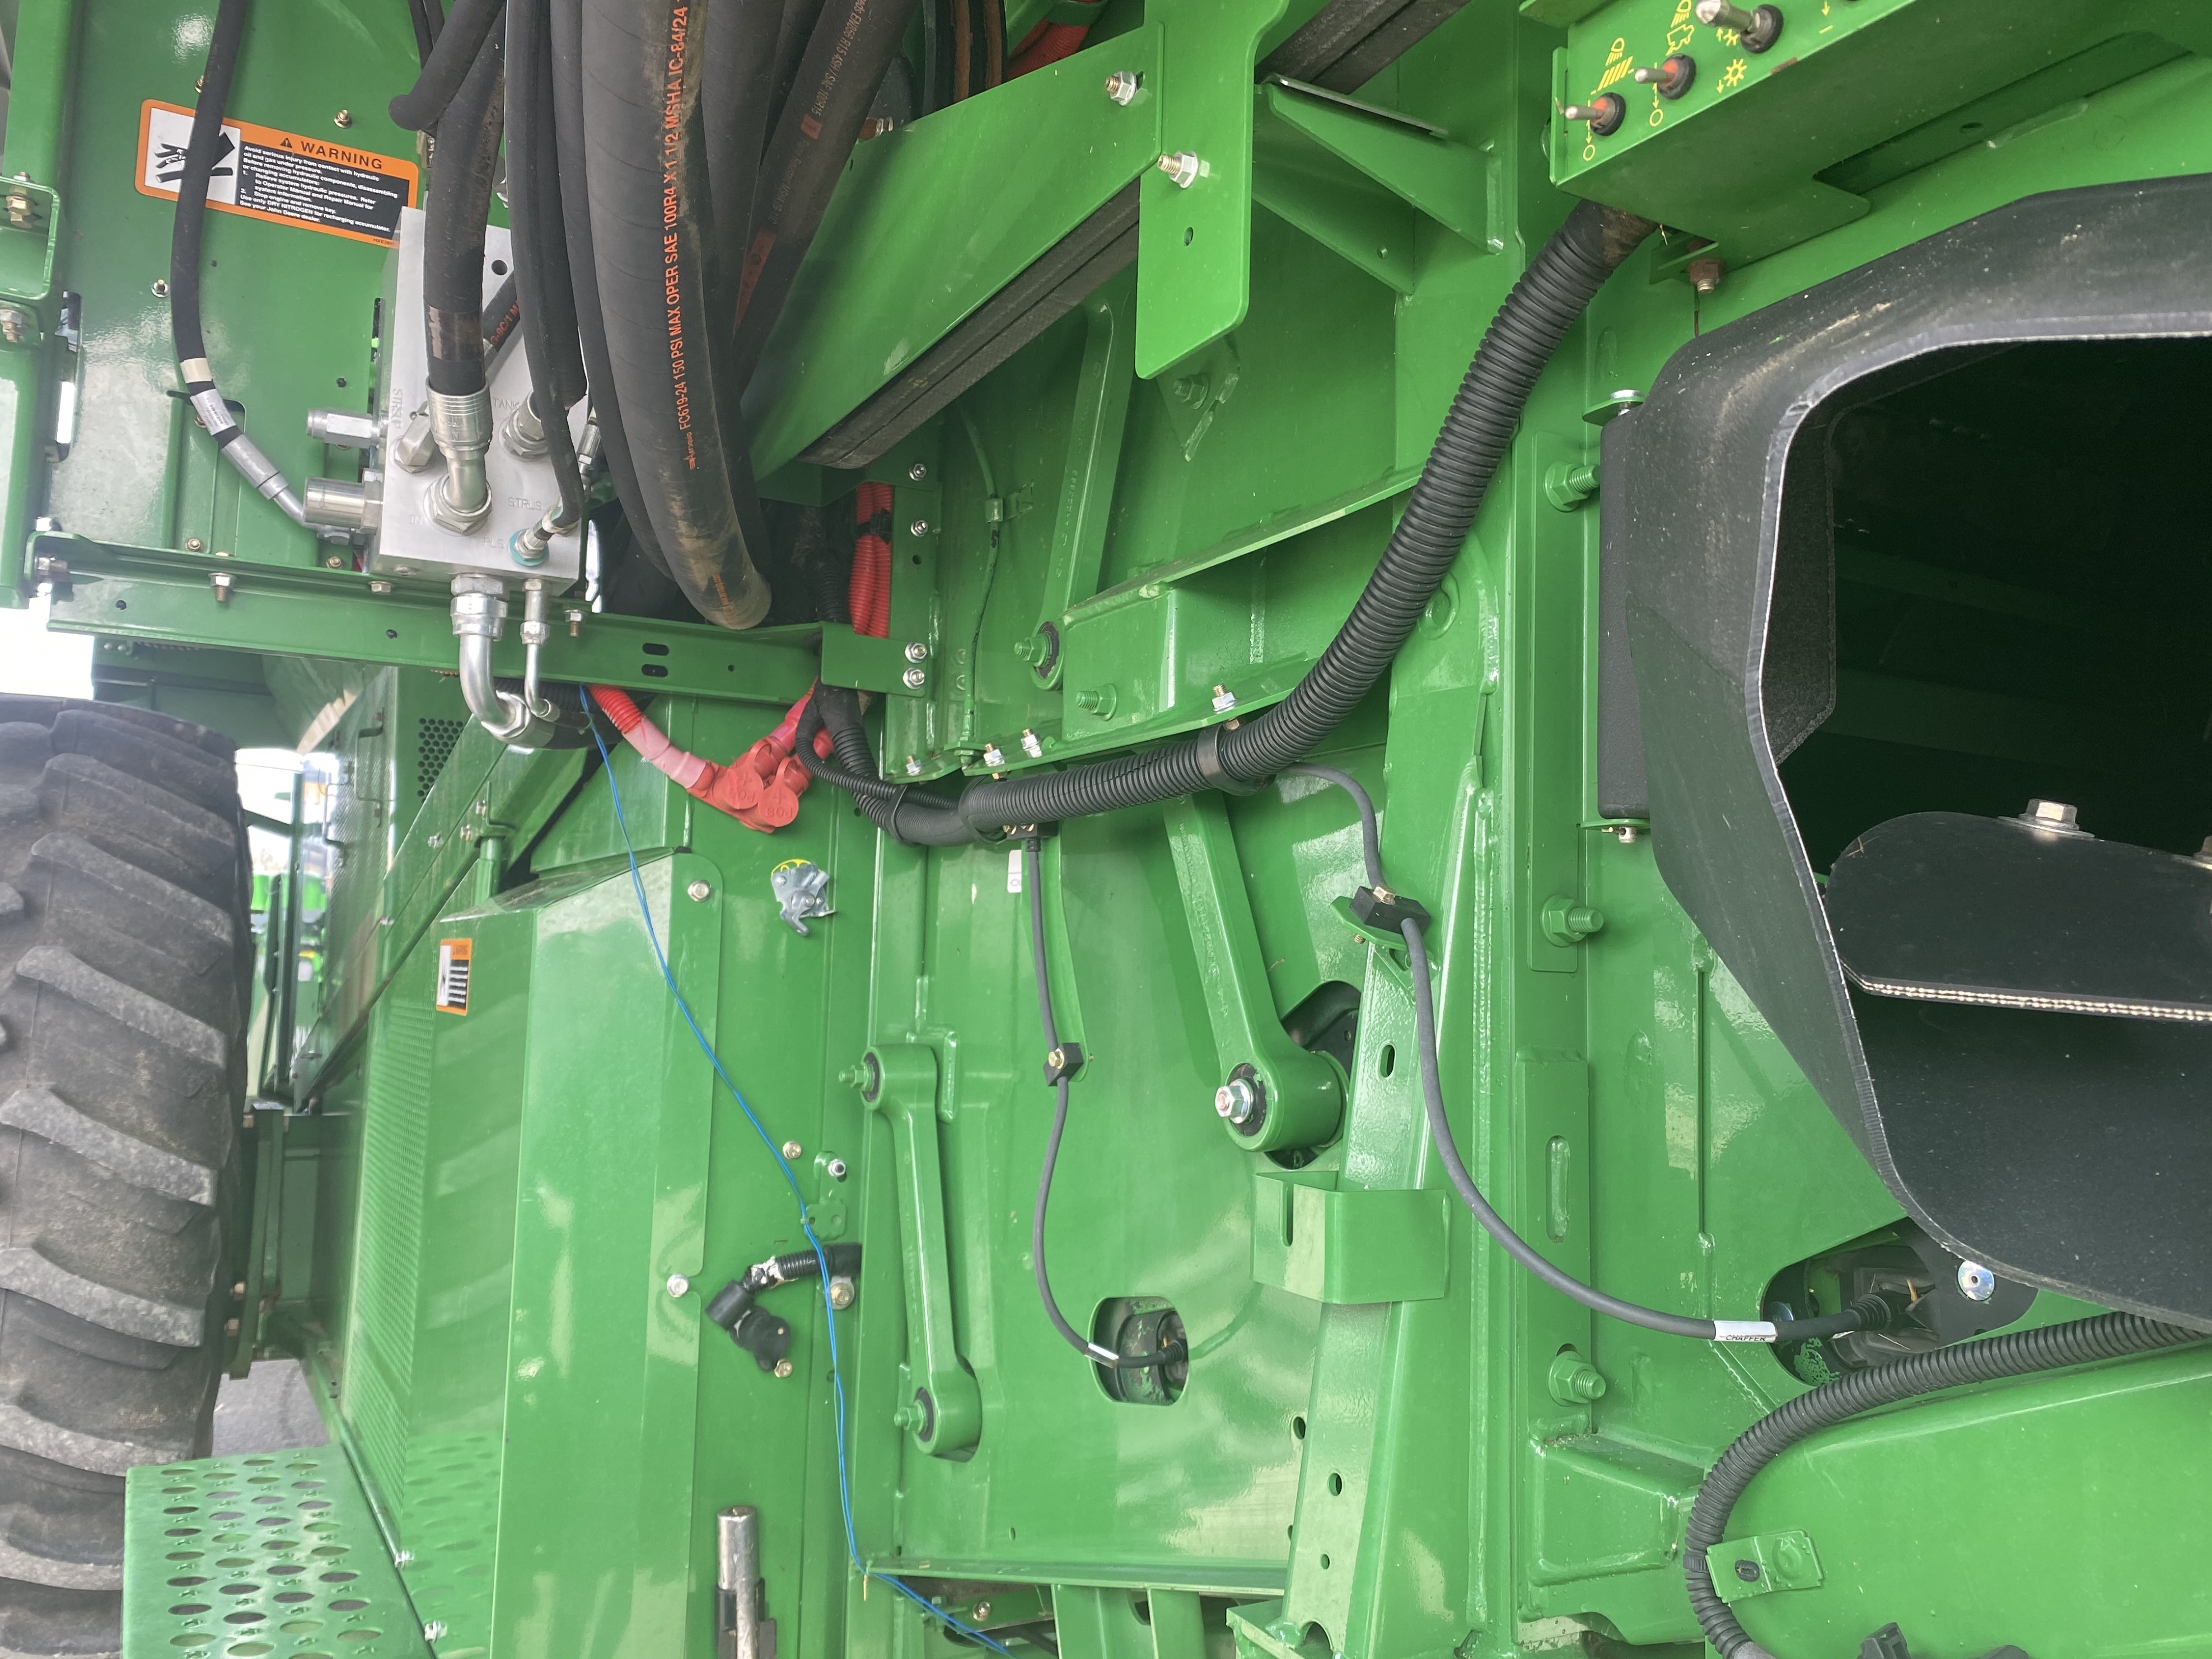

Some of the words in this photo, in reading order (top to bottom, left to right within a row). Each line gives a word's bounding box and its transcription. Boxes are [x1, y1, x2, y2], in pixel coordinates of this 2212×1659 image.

[843, 13, 861, 40] EN856
[668, 6, 688, 77] IC-84/24
[836, 37, 851, 56] R15
[829, 54, 843, 72] 4SH
[829, 68, 837, 76] /
[821, 73, 835, 91] SAE
[665, 78, 682, 129] MSHA
[812, 88, 829, 116] 100R15
[665, 132, 679, 155] 1/2
[301, 141, 382, 169] WARNING
[665, 157, 677, 168] 1
[250, 166, 278, 177] changing
[279, 173, 320, 186] accumulators:
[262, 150, 284, 159] serious
[285, 155, 302, 164] injury
[318, 163, 339, 172] contact
[353, 171, 379, 182] hydraulic
[295, 164, 322, 175] pressure.
[243, 158, 263, 166] Before
[264, 163, 292, 174] removing
[292, 170, 320, 180] hydraulic
[320, 176, 357, 189] components,
[357, 185, 397, 199] disassembling
[255, 173, 278, 182] Relieve
[278, 179, 300, 188] system
[300, 184, 328, 194] hydraulic
[328, 190, 358, 201] pressures.
[663, 172, 677, 184] X
[254, 186, 276, 195] system
[277, 190, 312, 203] information.
[262, 181, 289, 191] Operator
[289, 187, 311, 196] Manual
[324, 195, 343, 204] Repair
[343, 199, 364, 208] Manual
[269, 195, 289, 204] engine
[302, 203, 324, 211] remove
[663, 186, 678, 228] 100R4
[280, 203, 314, 215] NITROGEN
[323, 213, 354, 224] recharging
[355, 220, 391, 232] accumulator.
[301, 214, 321, 223] dealer.
[665, 233, 678, 264] SAE
[665, 266, 680, 305] OPER
[668, 306, 681, 336] MAX
[671, 339, 683, 359] PSI
[673, 362, 685, 381] 150
[492, 397, 520, 410] TANK
[675, 382, 691, 430] FC619-24
[508, 497, 543, 510] STRLS
[409, 514, 423, 525] IN
[483, 537, 504, 549] PLS
[766, 806, 792, 818] POS
